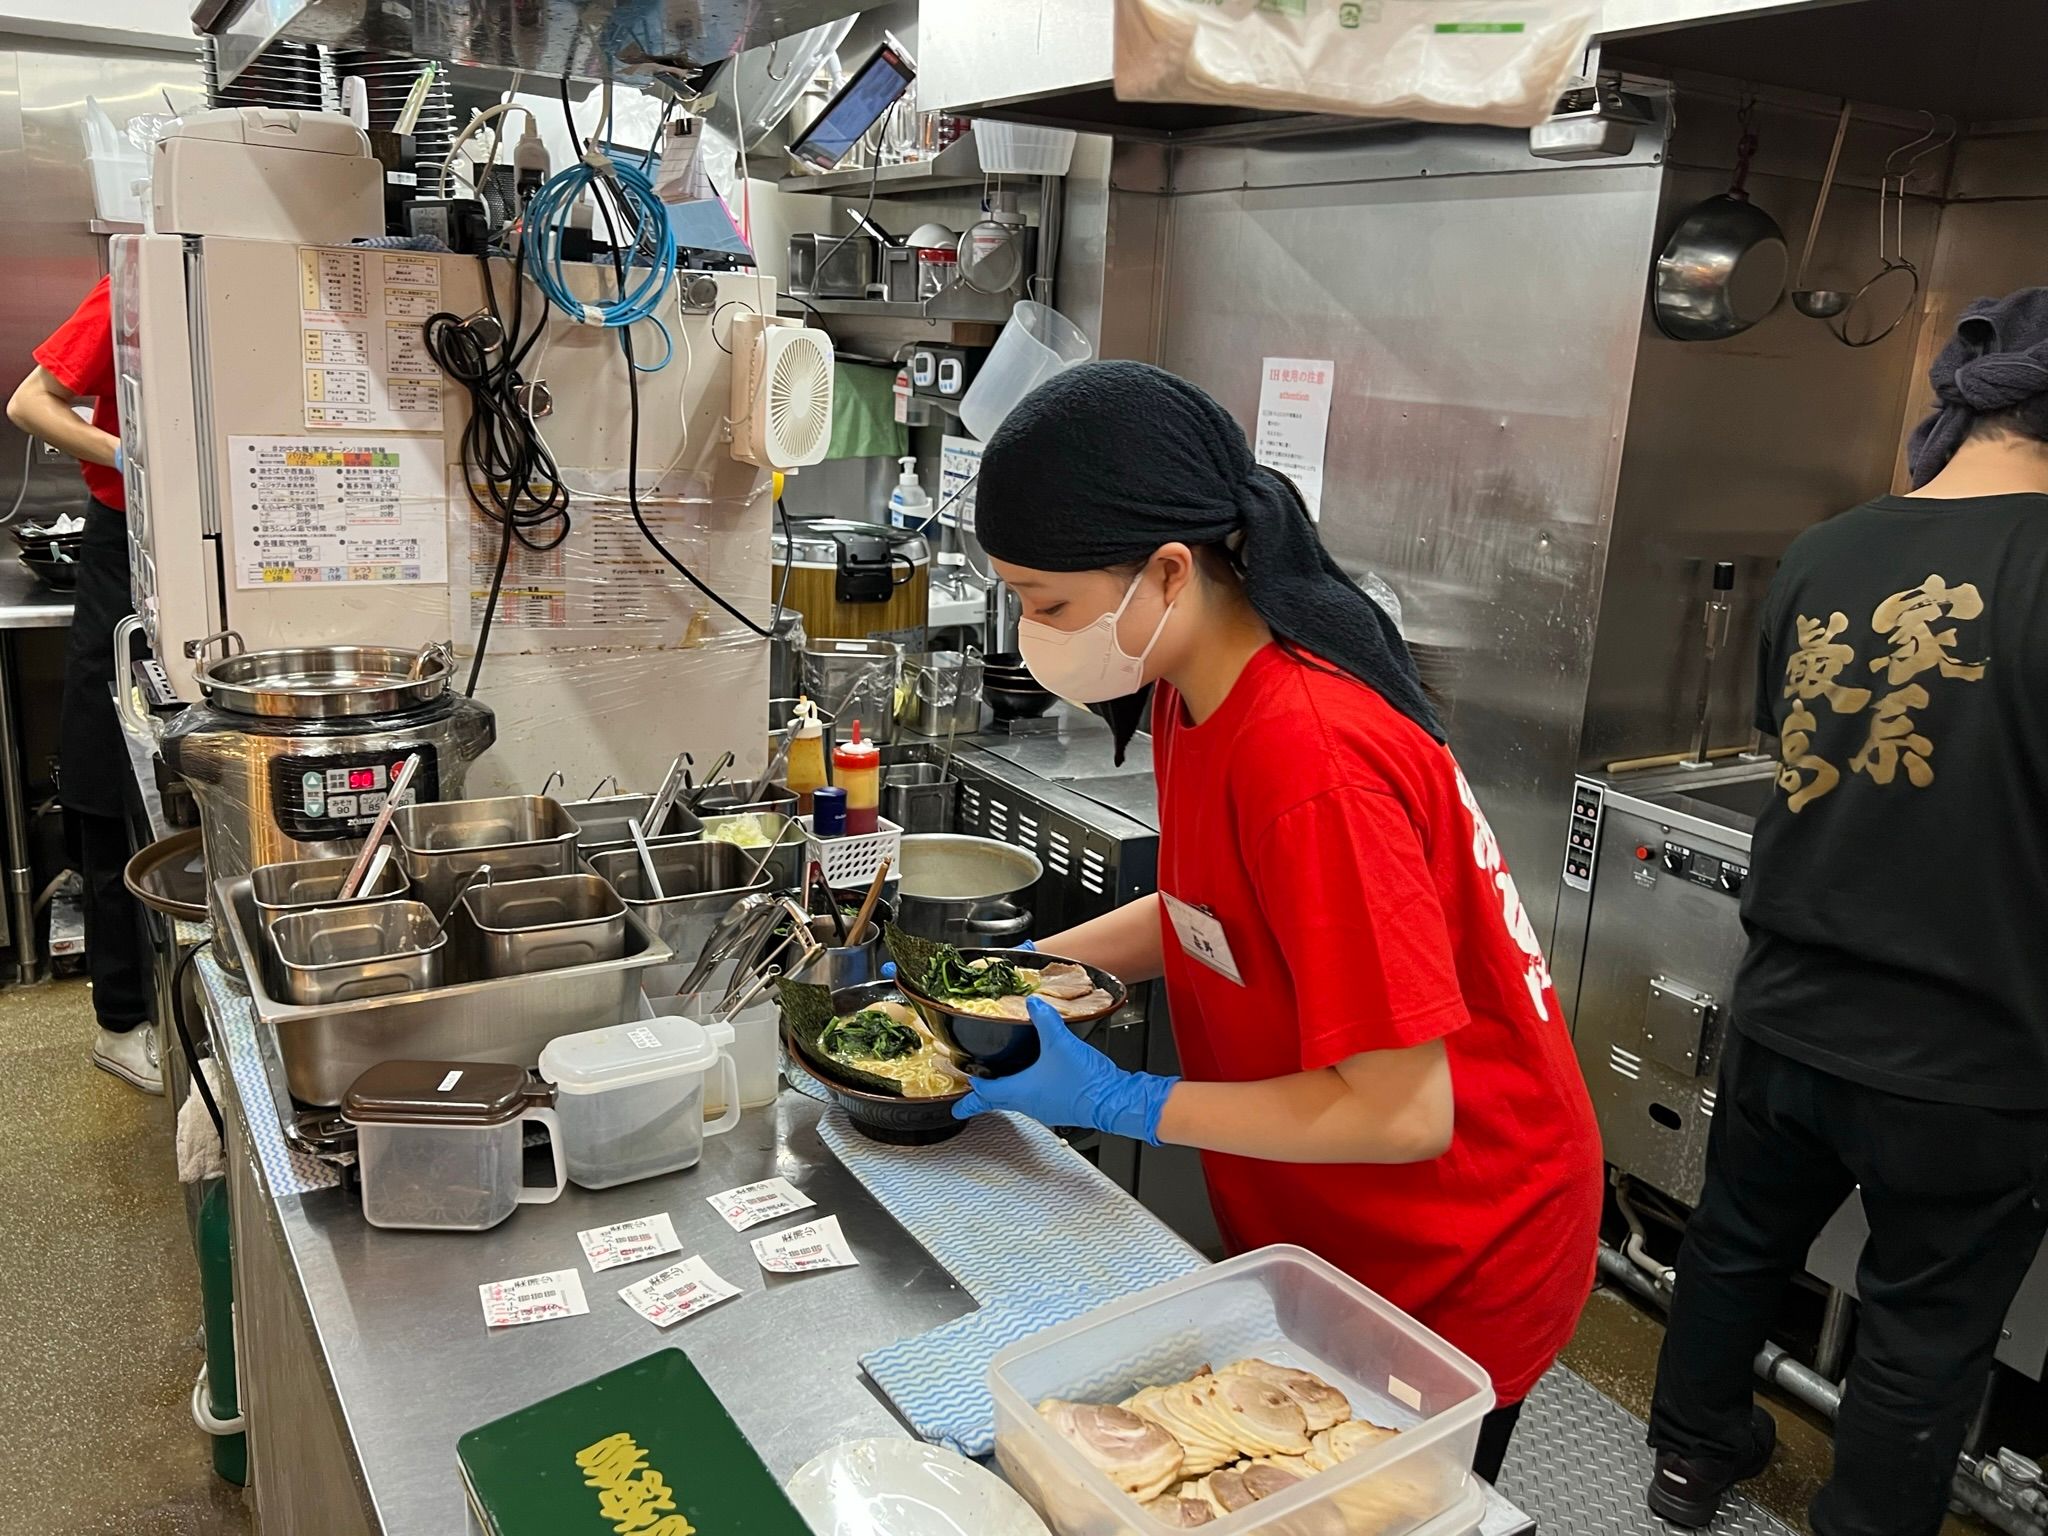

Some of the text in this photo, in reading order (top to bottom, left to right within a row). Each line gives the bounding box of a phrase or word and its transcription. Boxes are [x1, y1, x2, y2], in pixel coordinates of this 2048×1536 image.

[1848, 573, 1991, 788] 家系
[336, 806, 350, 814] 90
[368, 803, 380, 812] 85
